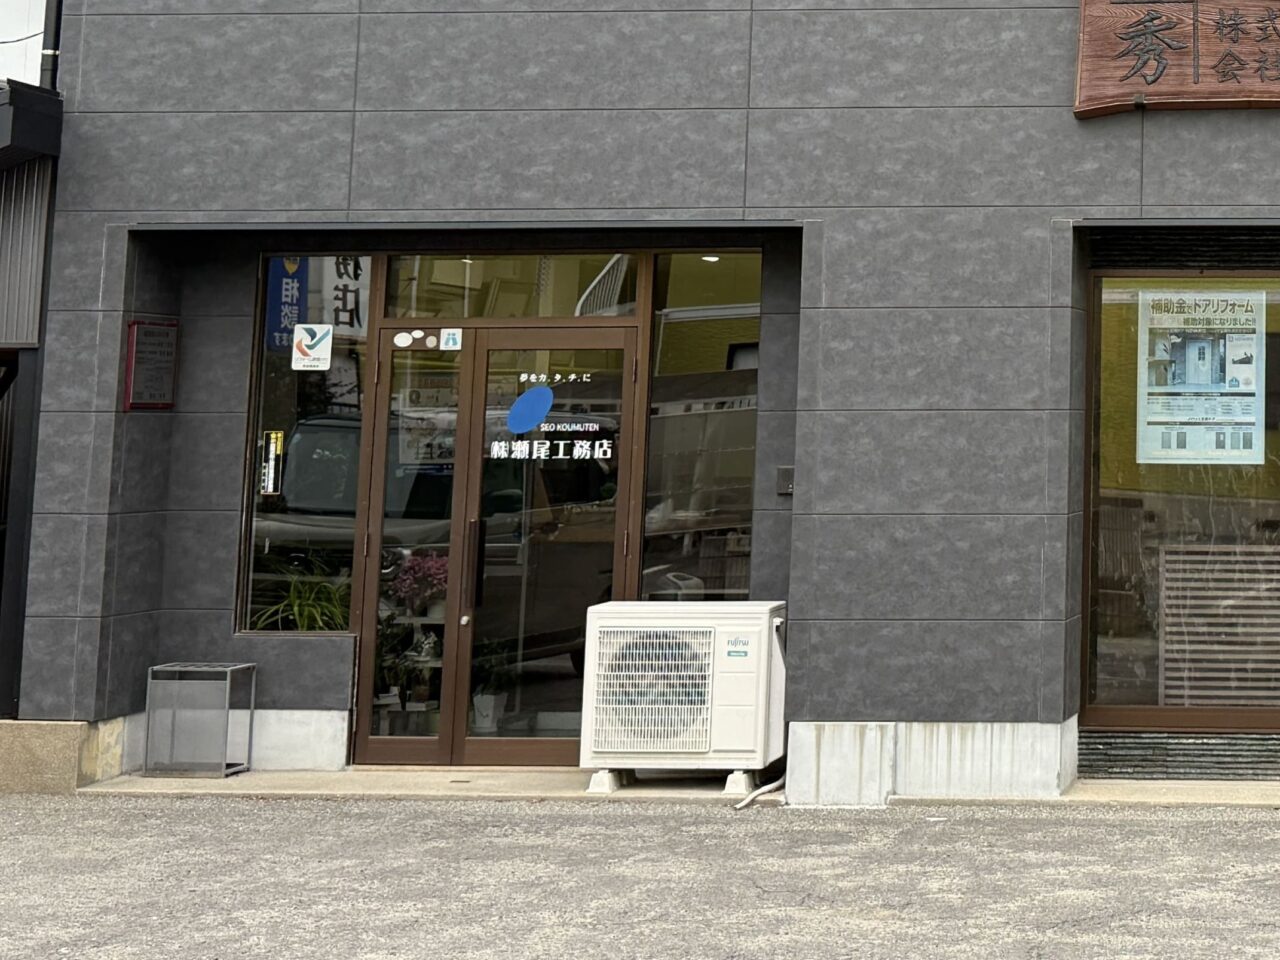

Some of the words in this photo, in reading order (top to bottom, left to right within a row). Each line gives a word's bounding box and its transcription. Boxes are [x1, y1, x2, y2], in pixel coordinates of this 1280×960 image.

[1151, 297, 1254, 315] 補助金でドアリフォーム
[540, 423, 555, 432] SEO
[556, 422, 600, 432] KOUMUTEN
